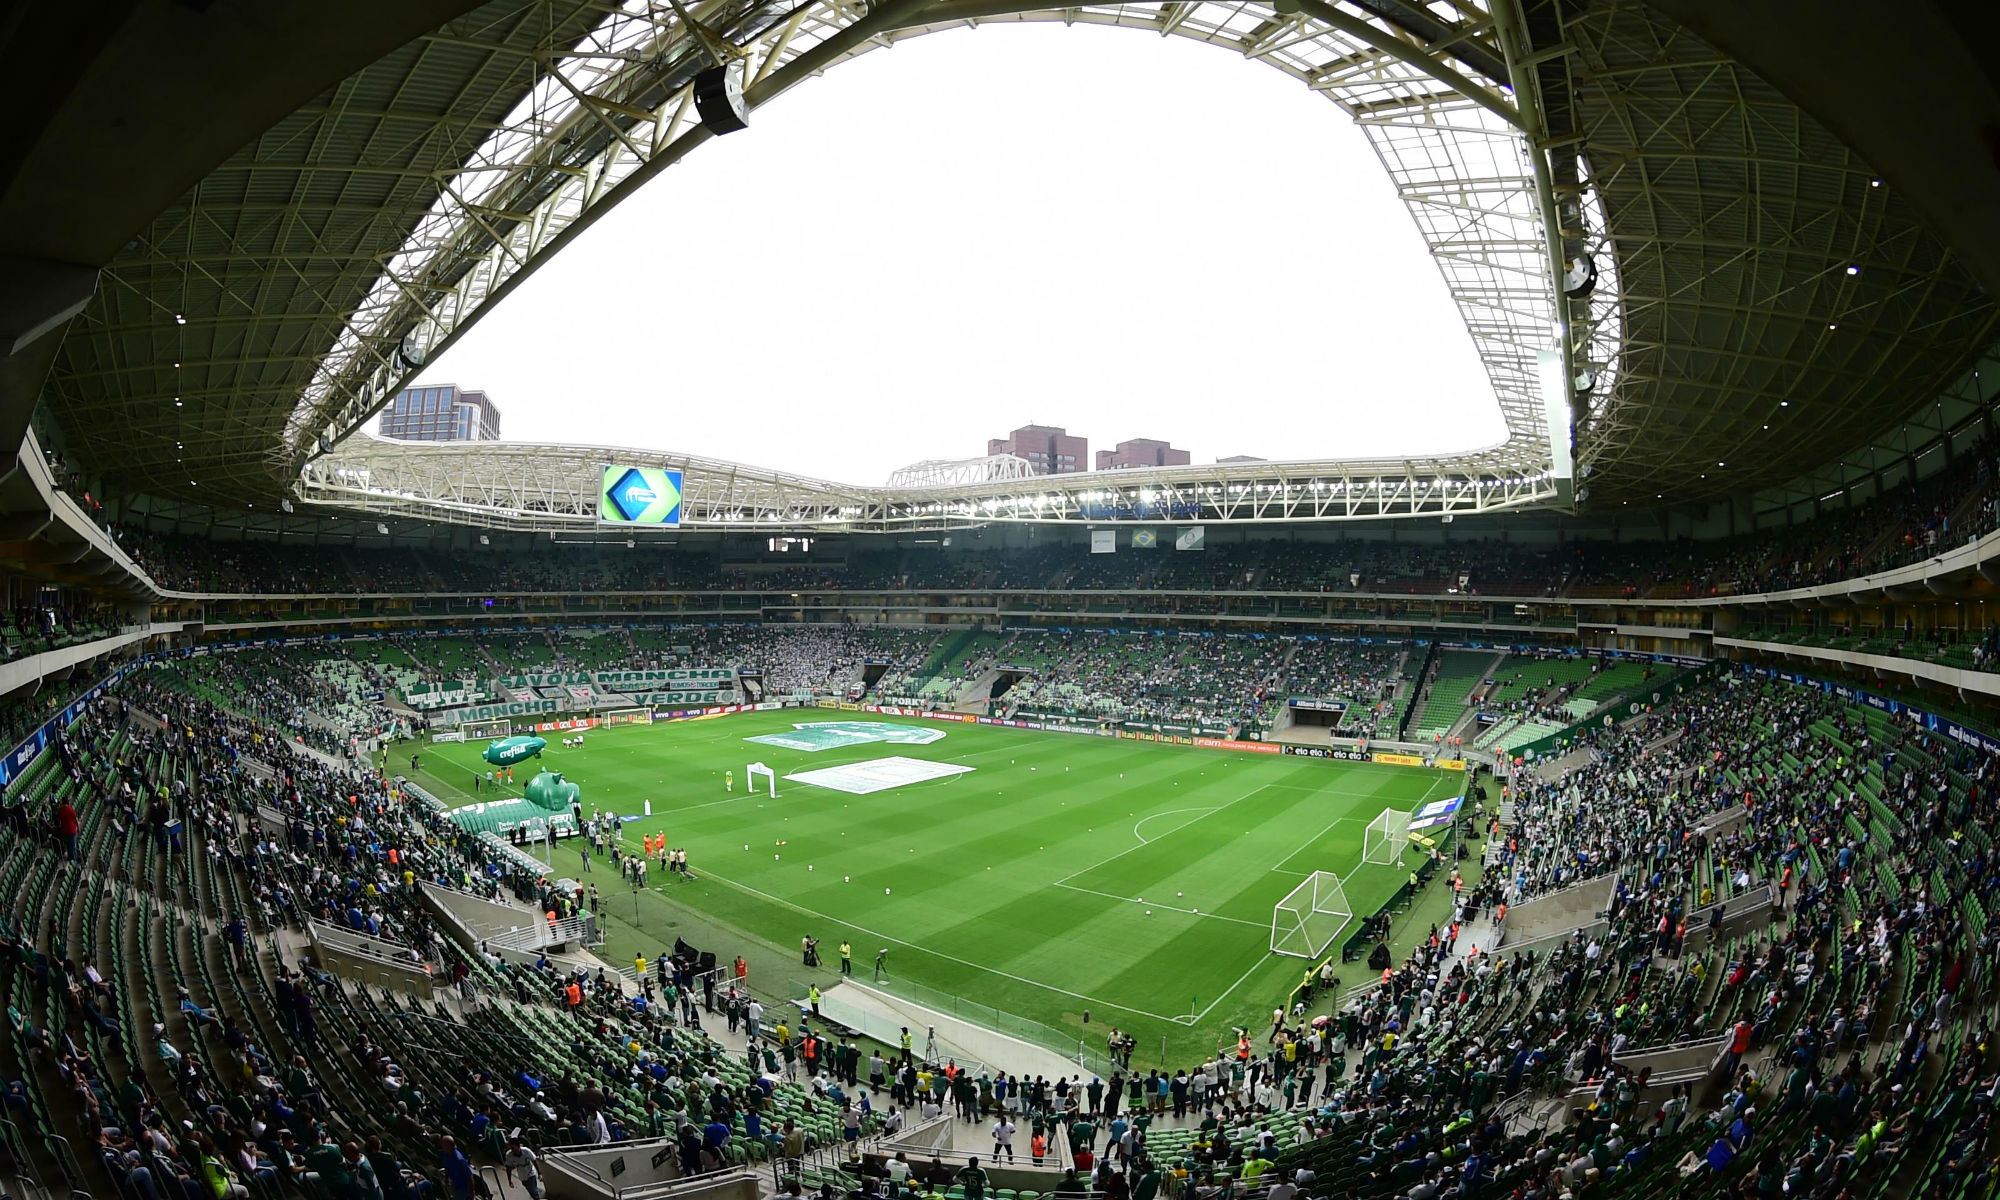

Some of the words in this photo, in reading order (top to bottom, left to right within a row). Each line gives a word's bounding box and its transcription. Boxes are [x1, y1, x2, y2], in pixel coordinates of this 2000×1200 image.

[501, 672, 591, 688] SAVOIA
[598, 669, 732, 682] MANCHA
[635, 692, 719, 705] VERDE
[1322, 702, 1340, 710] Parque
[457, 700, 557, 723] MANCHA
[542, 722, 555, 731] GOL
[559, 721, 572, 729] GOL
[576, 719, 589, 727] GOL
[1122, 731, 1136, 739] Itaú
[1140, 732, 1154, 741] Itaú
[1158, 734, 1173, 743] Itaú
[1177, 735, 1192, 745] Itaú
[500, 744, 526, 759] crefisa
[1295, 748, 1308, 756] elo
[1310, 749, 1323, 757] elo
[1334, 751, 1347, 760] elo
[1348, 752, 1362, 761] elo
[967, 1175, 978, 1187] 15
